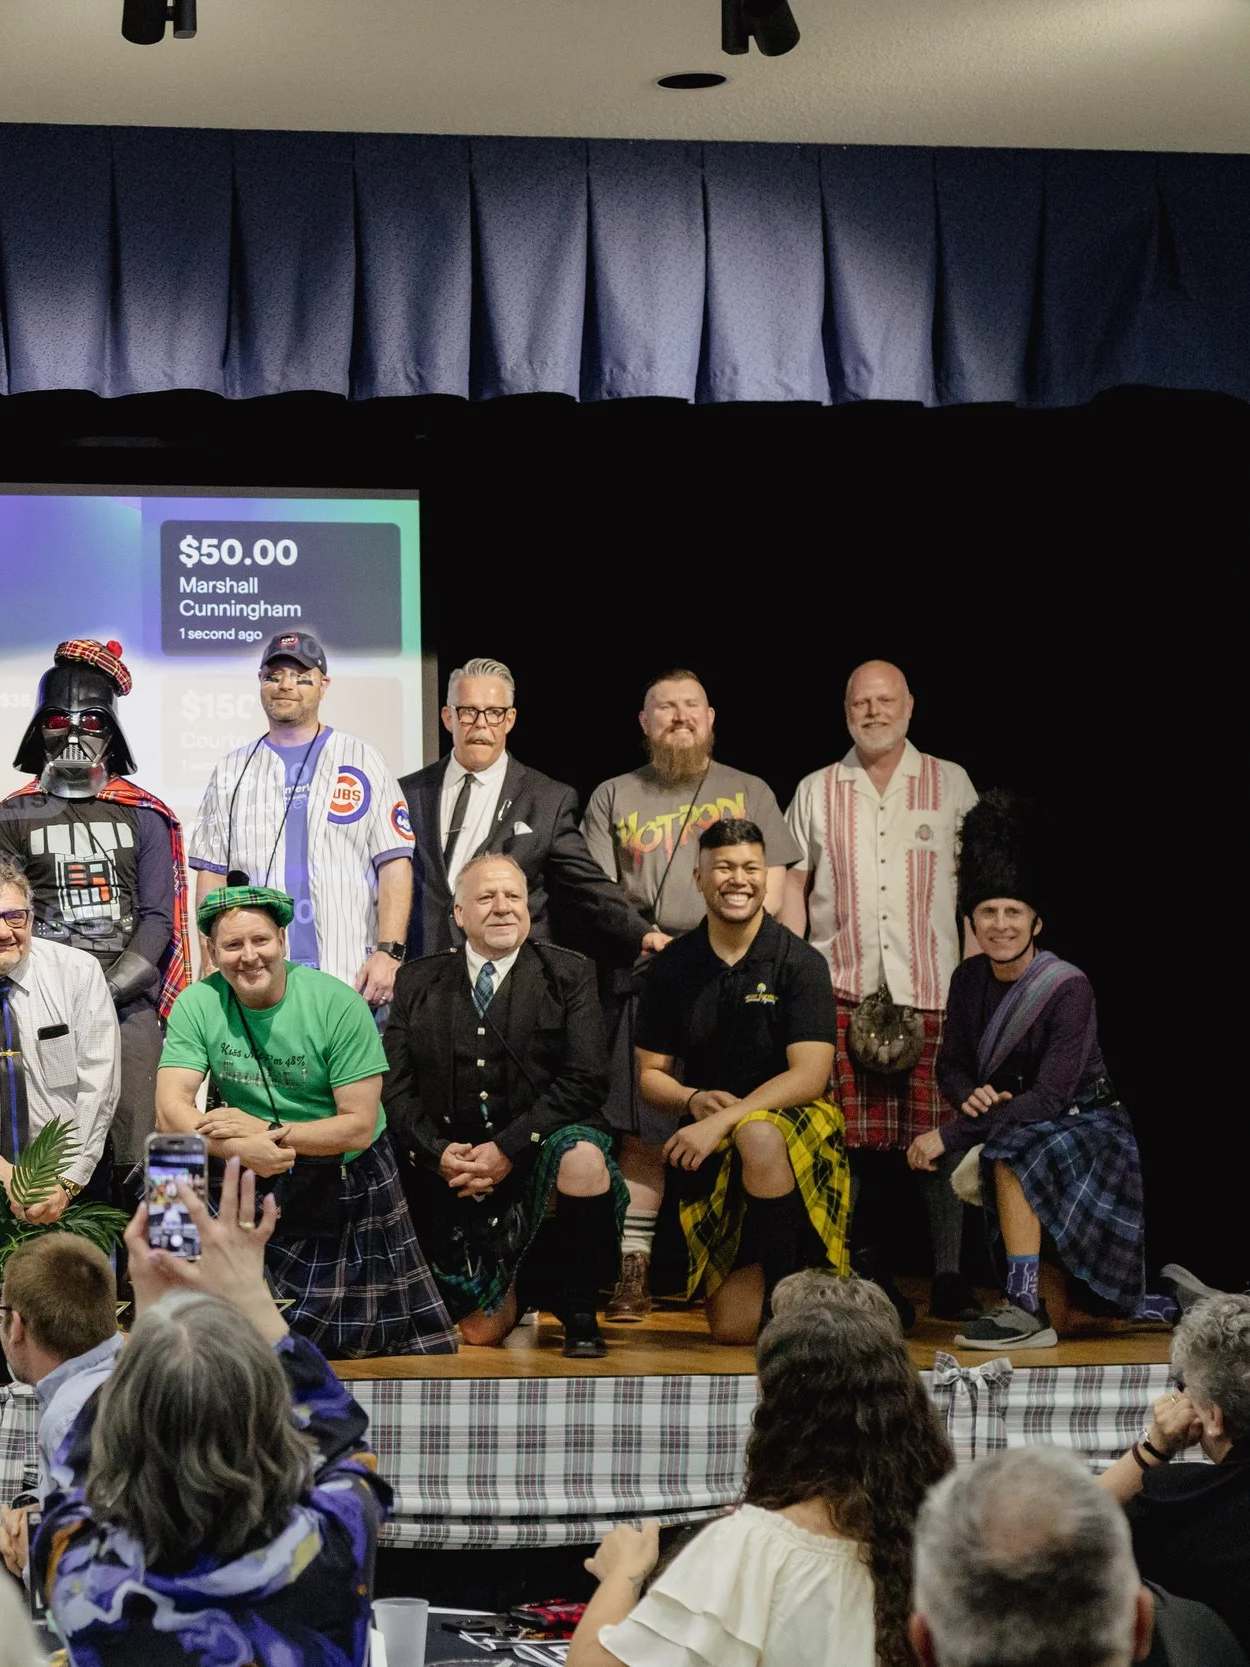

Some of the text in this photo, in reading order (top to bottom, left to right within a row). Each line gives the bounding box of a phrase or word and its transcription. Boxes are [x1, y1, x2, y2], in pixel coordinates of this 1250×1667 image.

[179, 535, 298, 568] $50.00
[179, 577, 259, 594] Marshall
[179, 600, 302, 621] Cunningham
[179, 628, 263, 642] 1 second ago
[220, 1042, 242, 1057] Kiss
[285, 1055, 306, 1068] 48%
